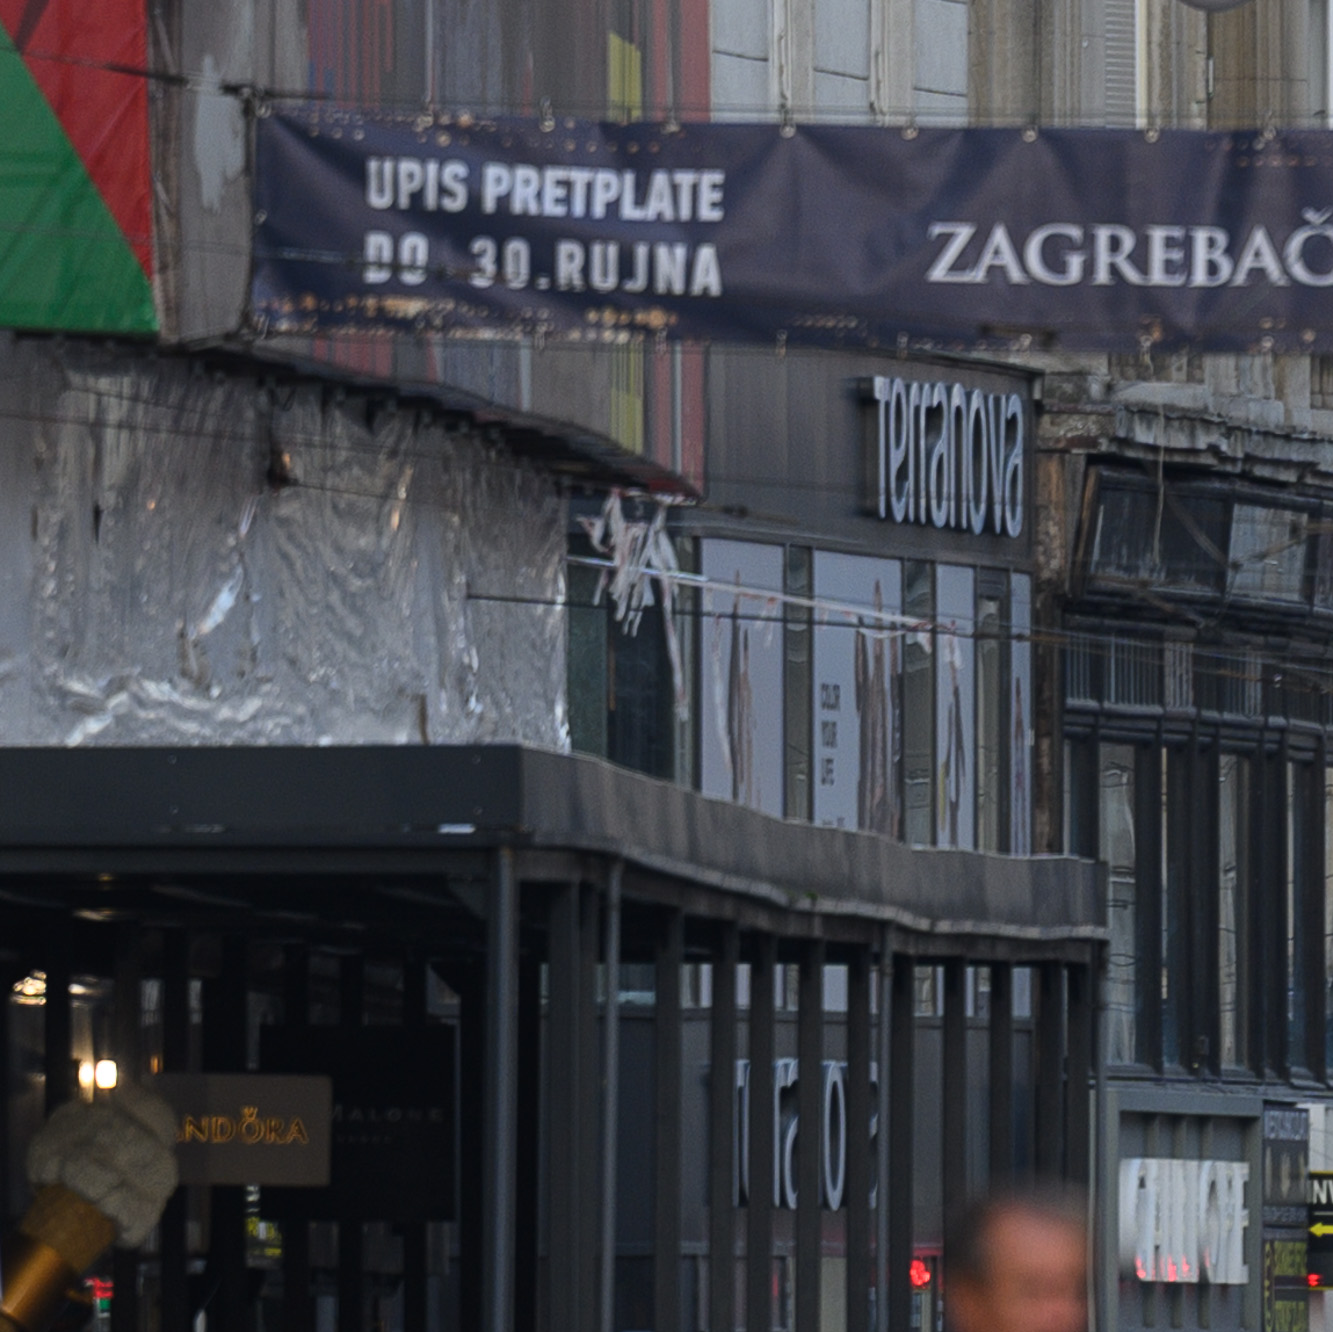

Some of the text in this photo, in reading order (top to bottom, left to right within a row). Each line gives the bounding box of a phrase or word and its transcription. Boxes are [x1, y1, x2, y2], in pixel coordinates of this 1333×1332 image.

[366, 158, 725, 223] UPIS PRETPLATE
[364, 232, 428, 286] DO
[177, 1107, 310, 1146] NDORA
